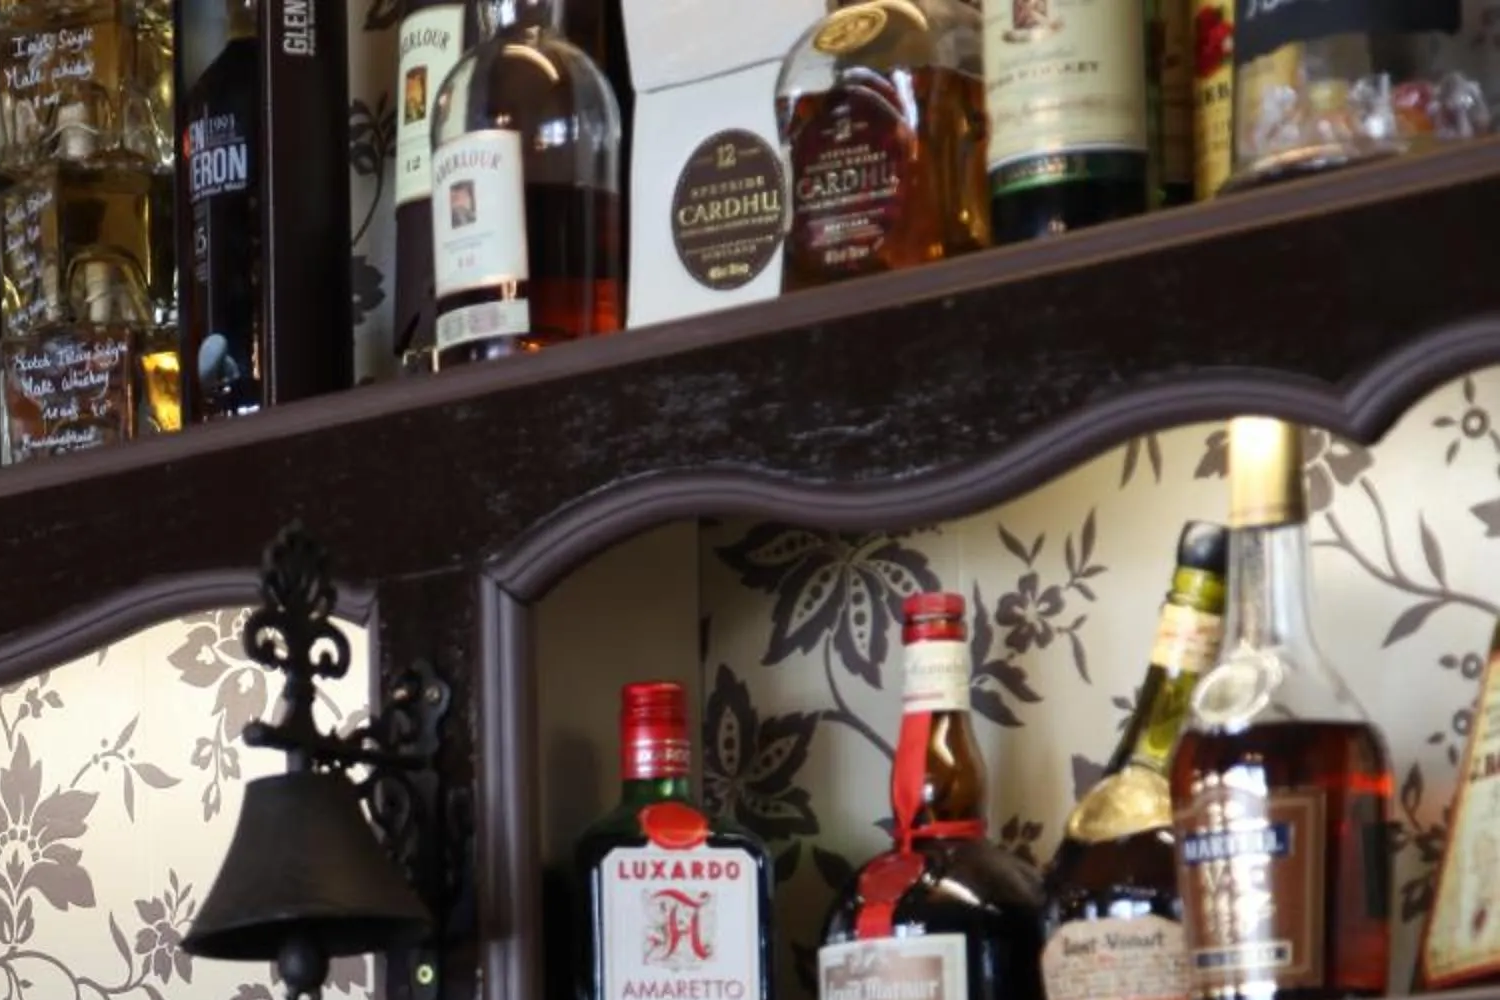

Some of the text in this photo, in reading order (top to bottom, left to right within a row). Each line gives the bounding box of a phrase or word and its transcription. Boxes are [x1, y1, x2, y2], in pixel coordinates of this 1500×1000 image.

[284, 0, 307, 54] GLEN
[717, 143, 737, 170] 12
[678, 189, 781, 226] CARDHU
[618, 860, 741, 881] LUXARDO
[621, 978, 746, 1000] AMARETTO
